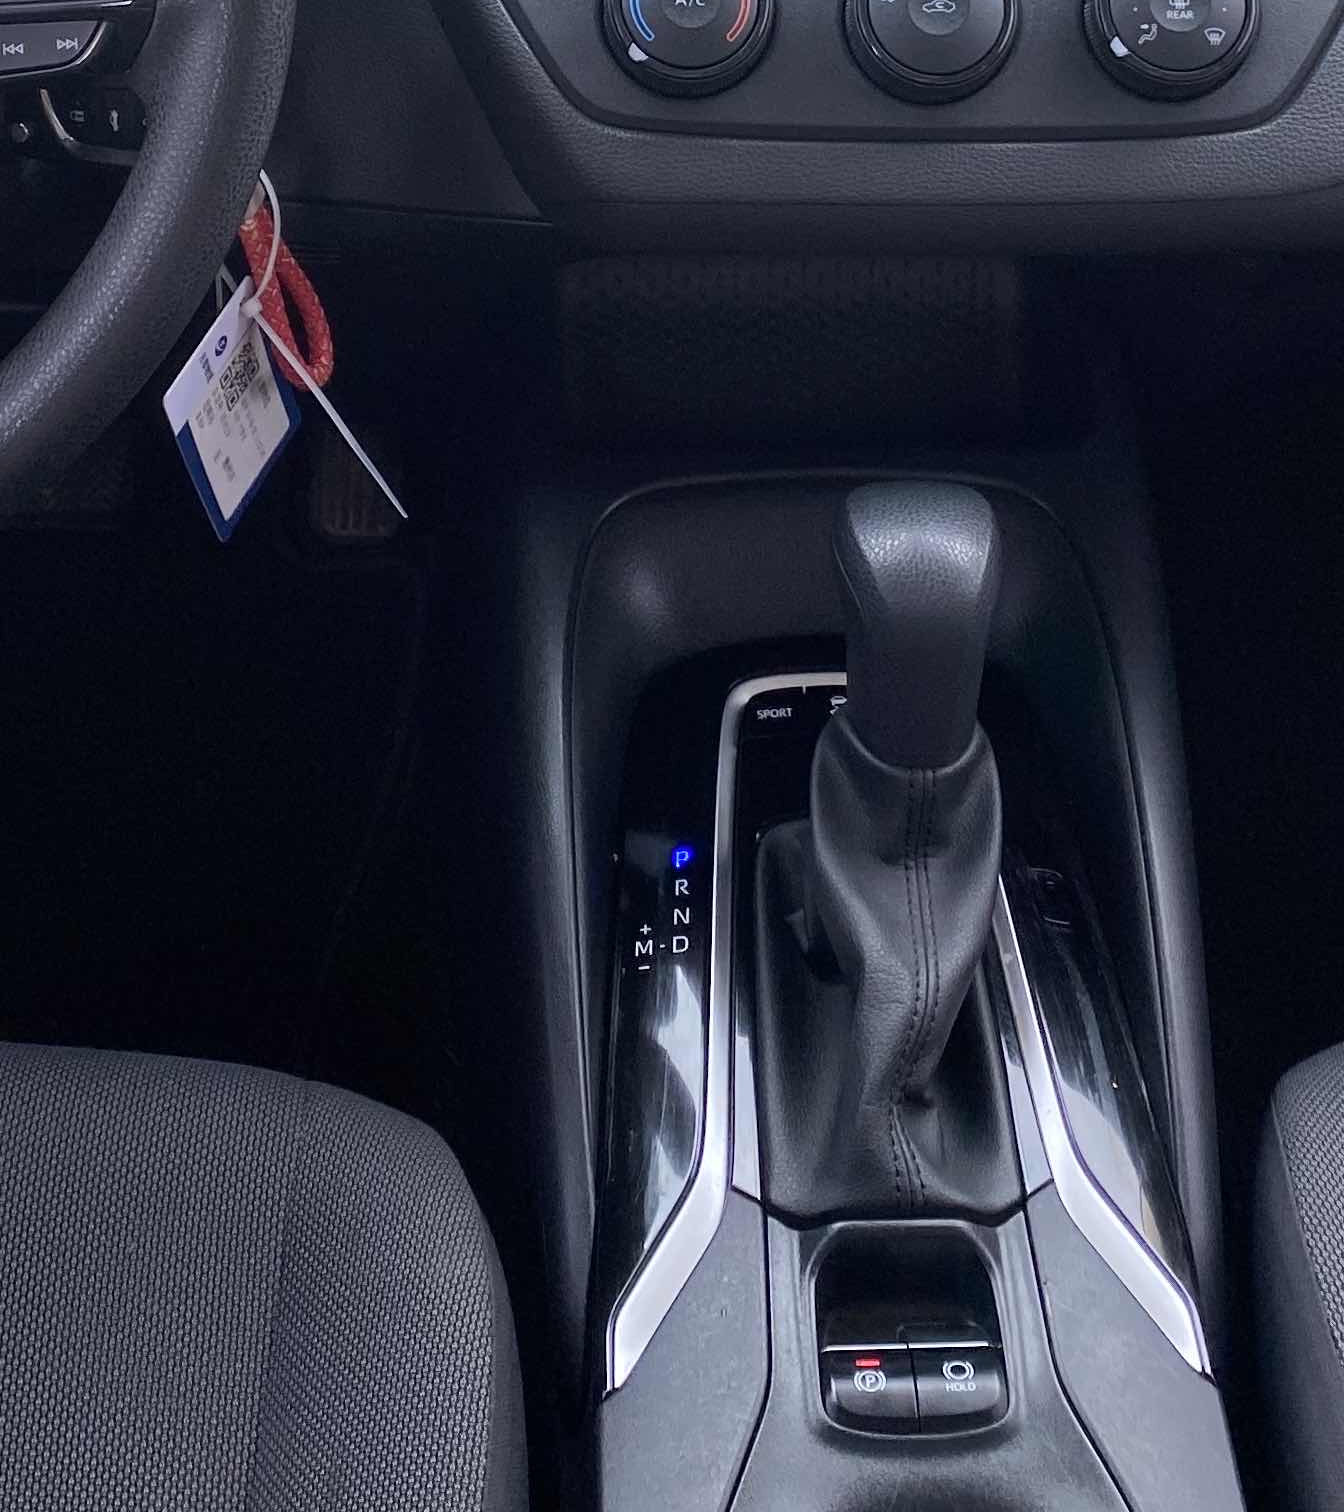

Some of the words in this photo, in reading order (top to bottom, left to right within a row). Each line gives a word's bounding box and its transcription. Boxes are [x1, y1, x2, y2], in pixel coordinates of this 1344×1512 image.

[1166, 10, 1194, 20] REAR
[756, 707, 793, 720] SPORT
[675, 850, 689, 868] P
[675, 879, 690, 896] R
[673, 907, 691, 926] N
[635, 940, 654, 957] M
[672, 936, 689, 954] D
[946, 1382, 976, 1392] HOLD
